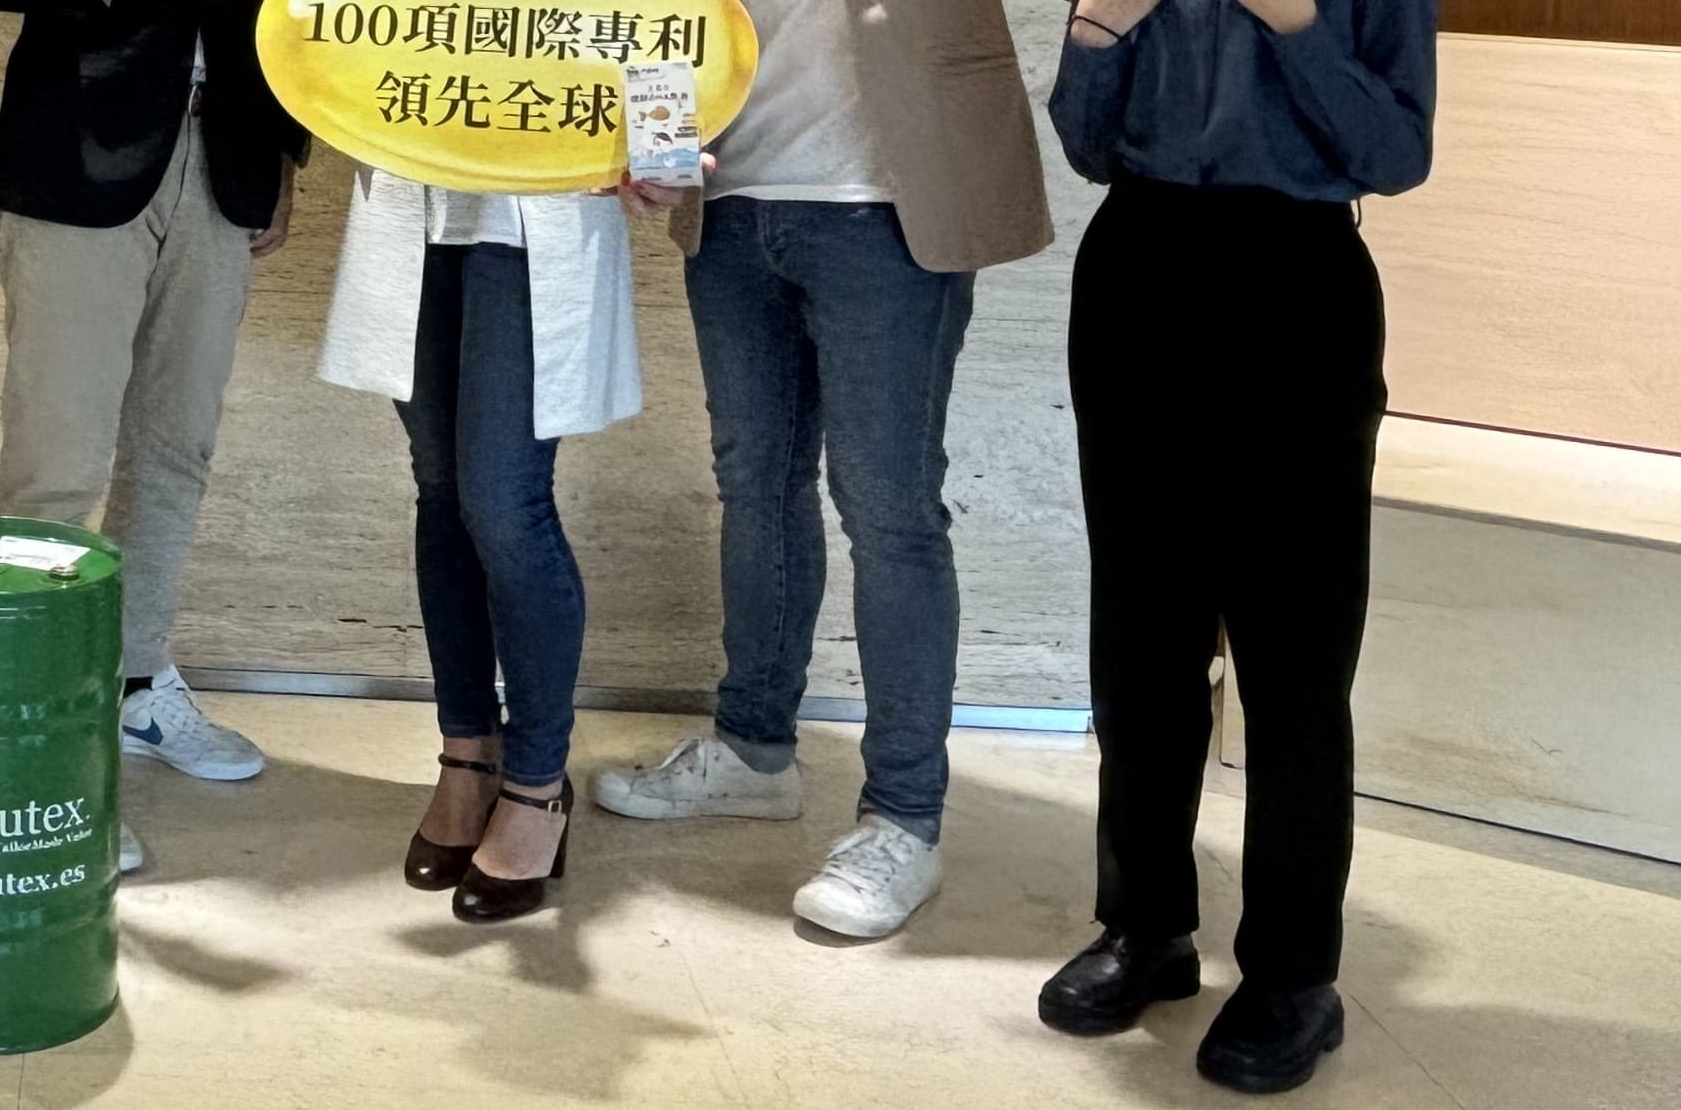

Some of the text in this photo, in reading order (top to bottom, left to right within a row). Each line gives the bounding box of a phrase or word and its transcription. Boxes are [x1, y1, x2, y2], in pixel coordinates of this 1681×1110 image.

[302, 0, 709, 69] 100項國際專利
[373, 68, 620, 140] 領先全球
